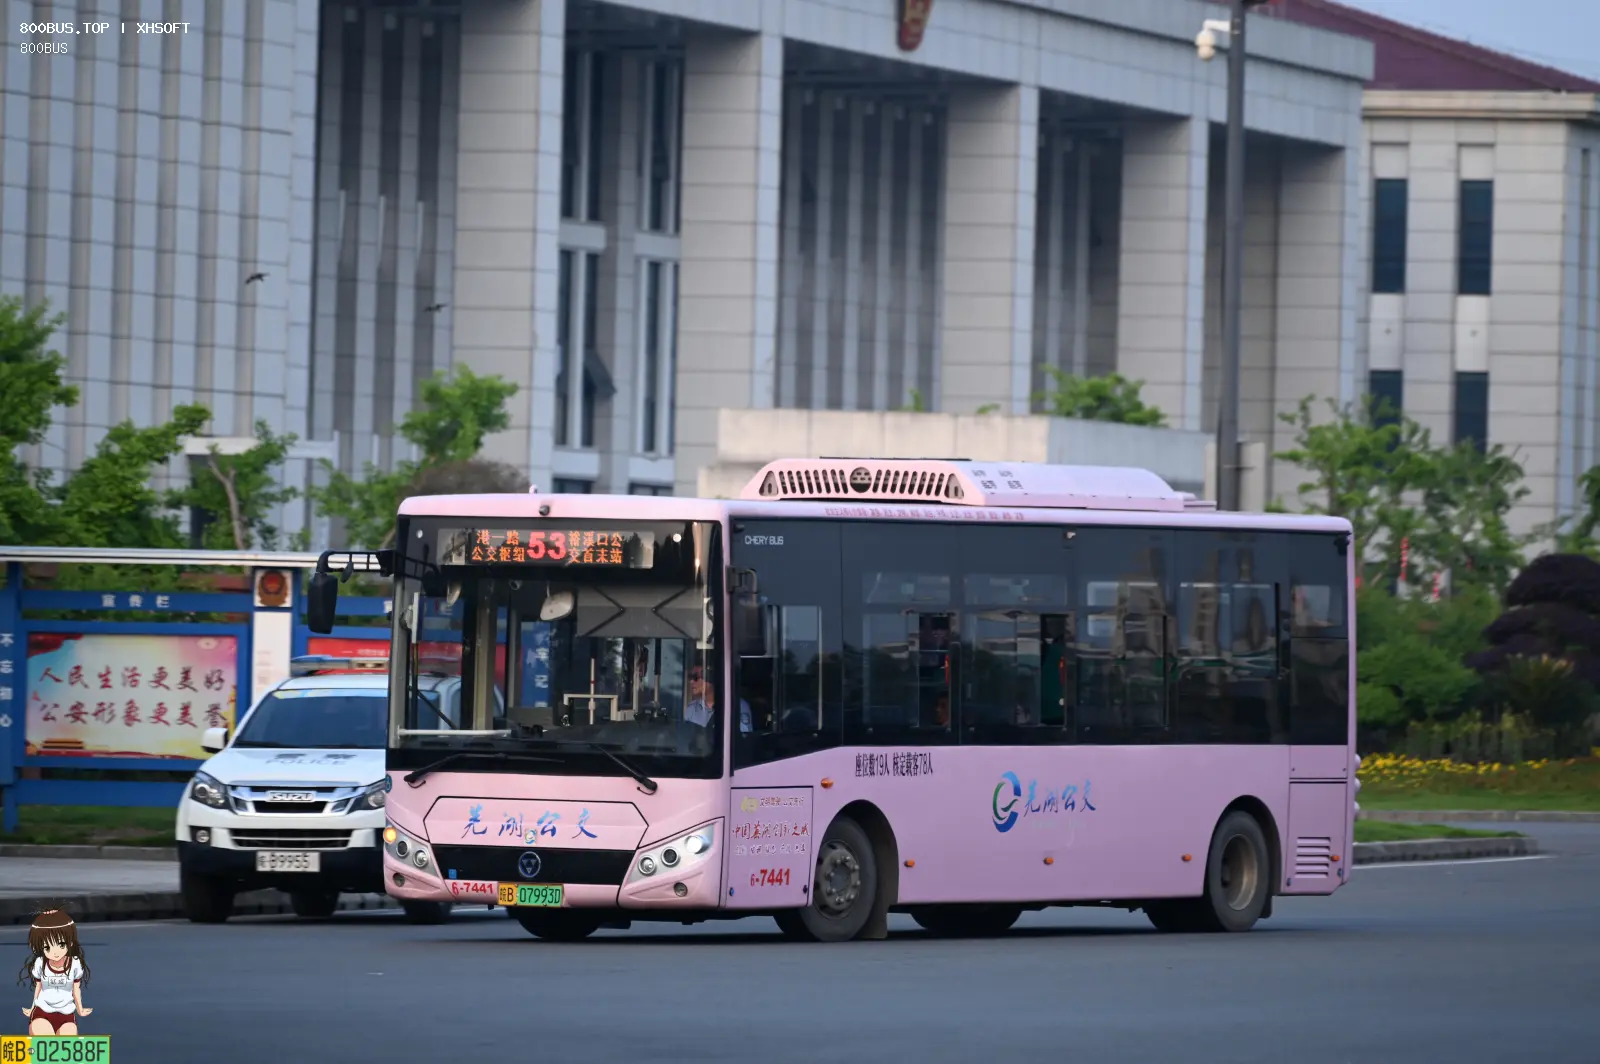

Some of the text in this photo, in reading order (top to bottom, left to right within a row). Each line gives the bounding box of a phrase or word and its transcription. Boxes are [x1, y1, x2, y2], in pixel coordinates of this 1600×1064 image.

[477, 530, 520, 546] 港一路
[526, 532, 567, 560] 53
[744, 535, 784, 545] CHERY BUS
[568, 549, 623, 564] 交首末站
[102, 594, 170, 608] 宣传栏
[40, 665, 226, 692] 人民生活更美好
[39, 699, 228, 728] 公安形象更美誉
[855, 753, 889, 777] 座位数19人
[268, 791, 314, 802] ISUZU
[750, 868, 790, 886] 6-7441
[451, 882, 494, 895] 6-7441
